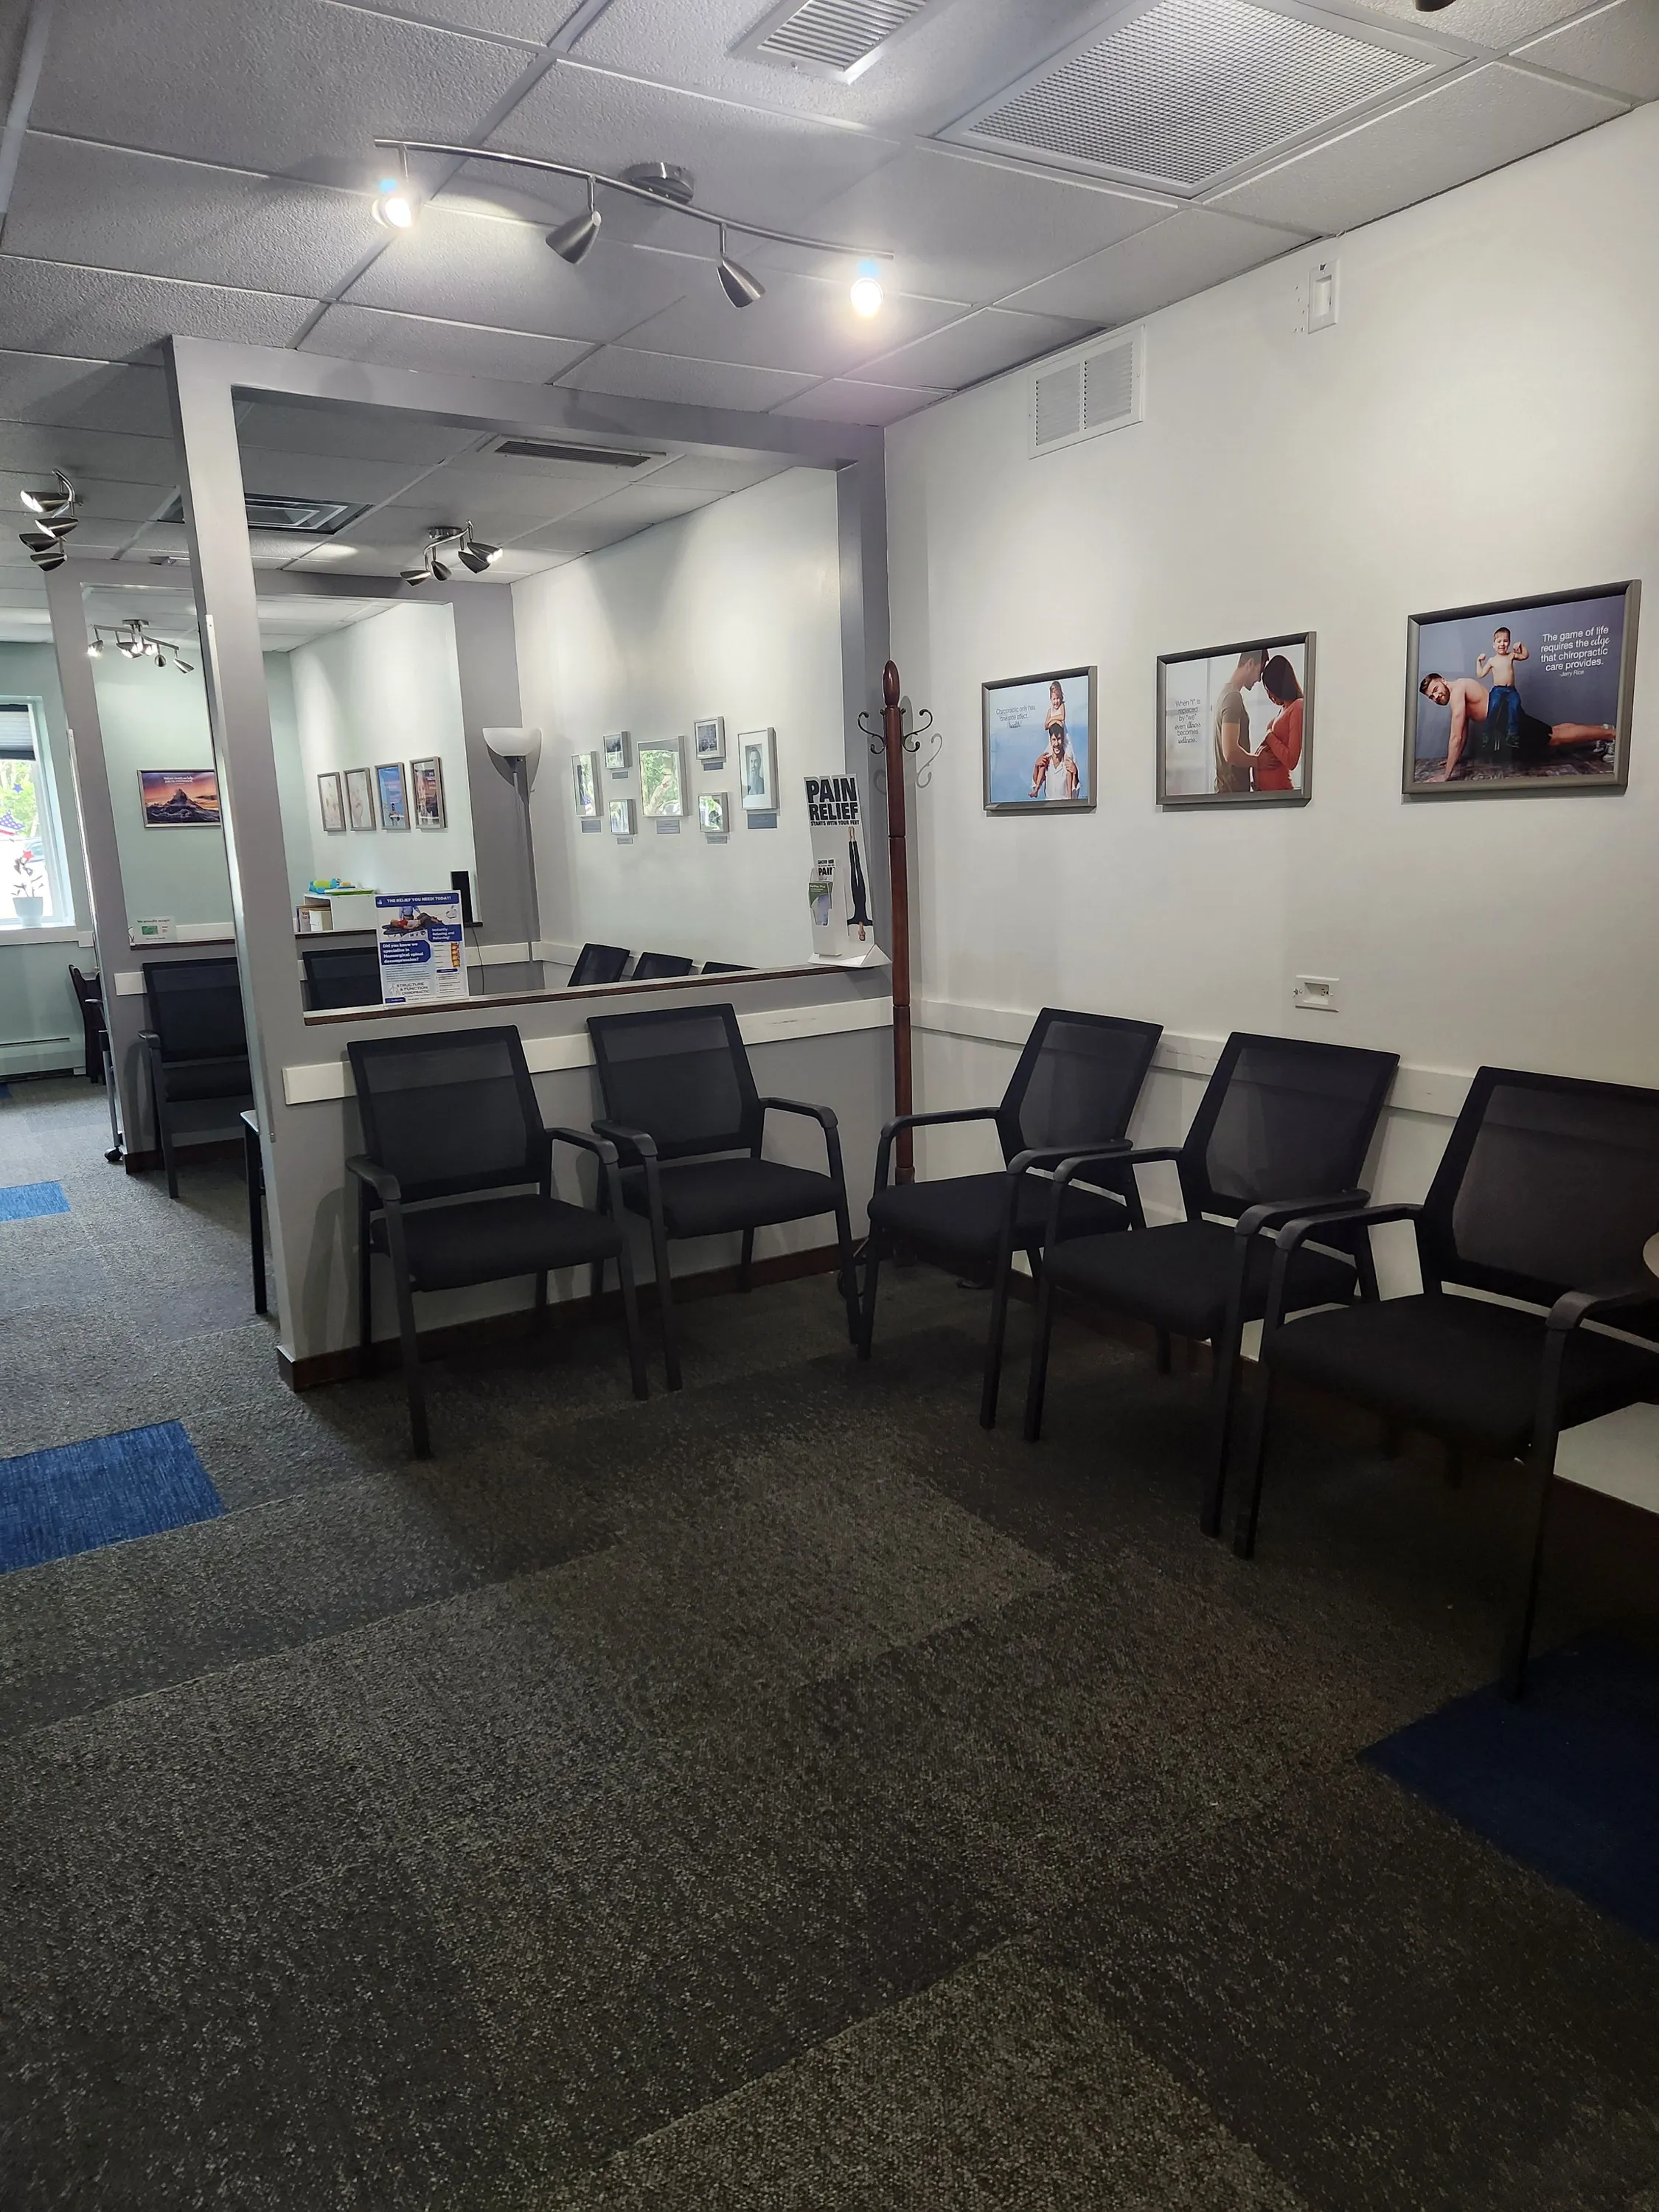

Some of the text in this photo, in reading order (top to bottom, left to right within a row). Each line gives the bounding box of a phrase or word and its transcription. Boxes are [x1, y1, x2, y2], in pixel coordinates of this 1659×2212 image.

[1543, 625, 1609, 642] The game of life
[1540, 635, 1610, 653] requires the edge
[1540, 647, 1608, 662] that chiropractic
[1545, 658, 1604, 671] care provides.
[806, 777, 858, 803] PAIN
[808, 802, 858, 821] RELIEF
